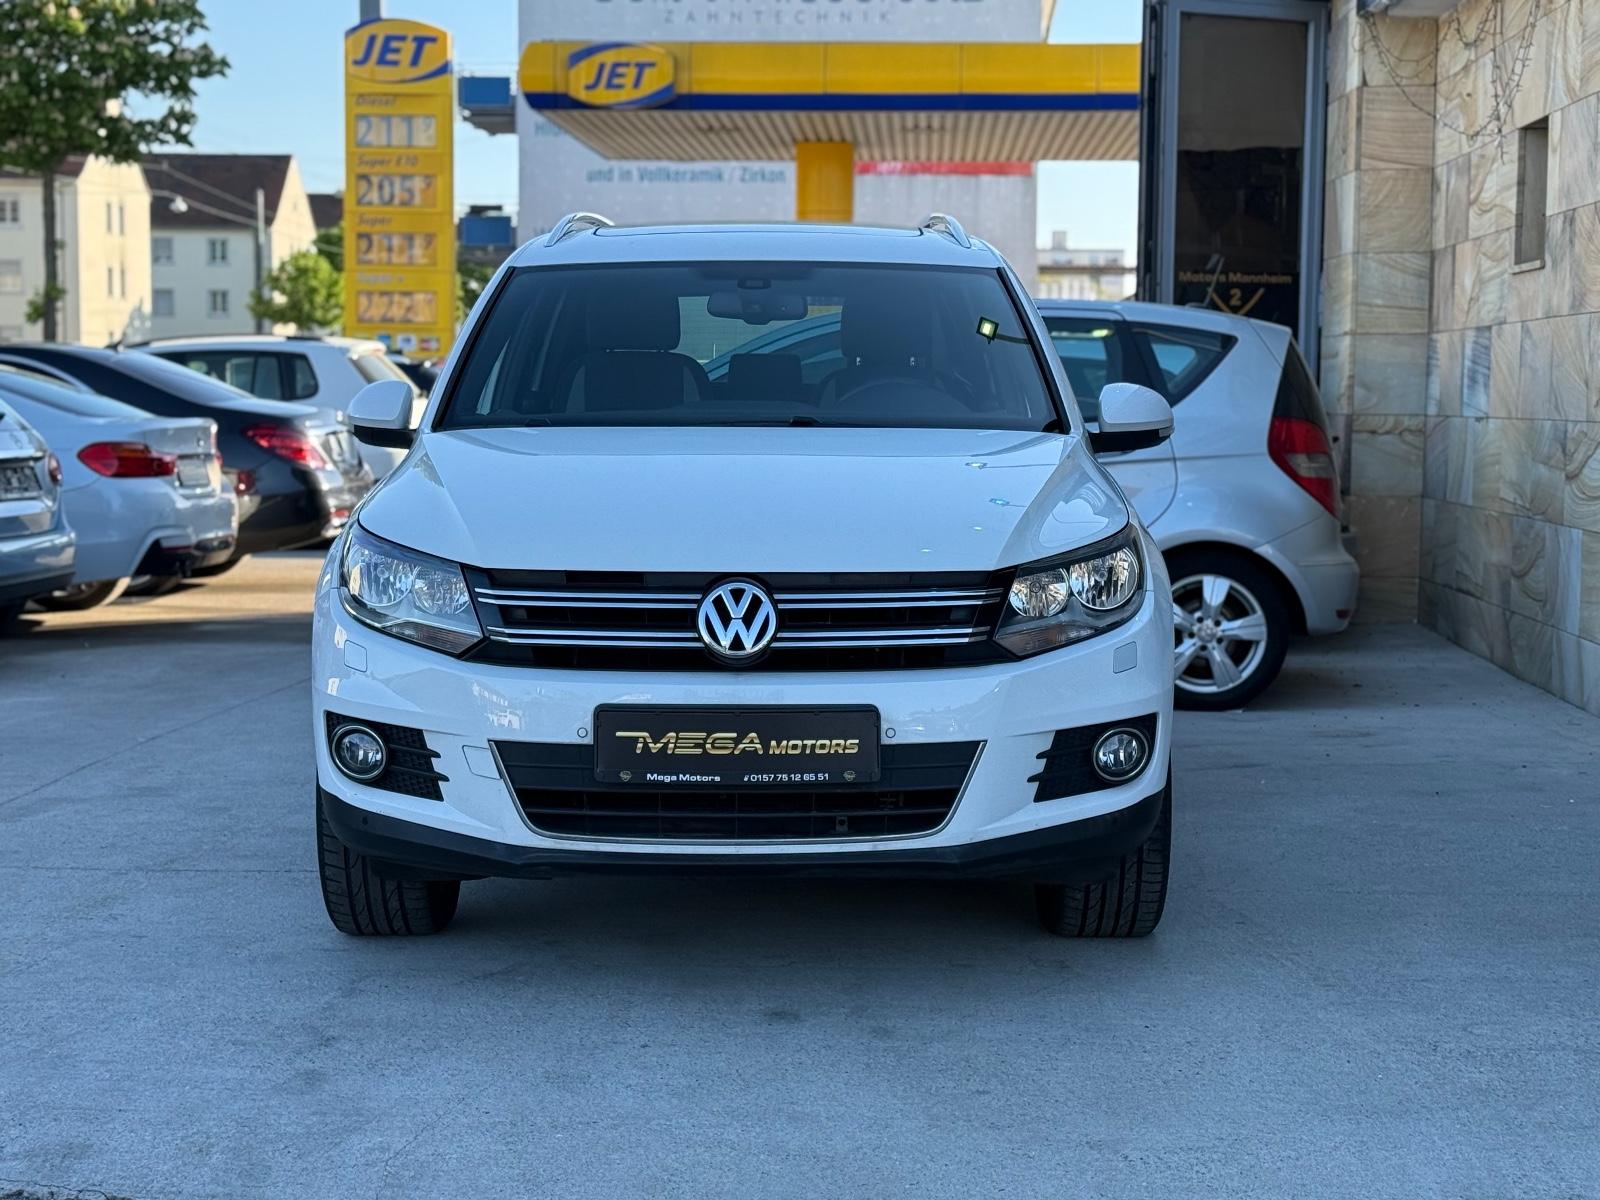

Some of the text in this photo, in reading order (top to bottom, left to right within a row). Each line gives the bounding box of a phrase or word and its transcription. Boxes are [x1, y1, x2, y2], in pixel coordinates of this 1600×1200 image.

[664, 9, 890, 25] ZAHNTECHNIK
[352, 34, 438, 68] JET
[584, 61, 657, 91] JET
[357, 154, 393, 169] Super
[586, 166, 613, 182] und
[618, 167, 633, 182] in
[638, 166, 723, 182] Vollkeramik
[740, 166, 786, 182] Zirkon
[1178, 271, 1293, 284] Motos Mannheim
[1229, 288, 1242, 306] 2
[616, 731, 860, 755] MEGA MOTORS
[646, 773, 677, 782] Mega
[679, 773, 721, 782] Motors
[750, 773, 776, 782] 0157
[777, 773, 789, 782] 75
[789, 773, 801, 782] 12
[817, 773, 829, 782] 51
